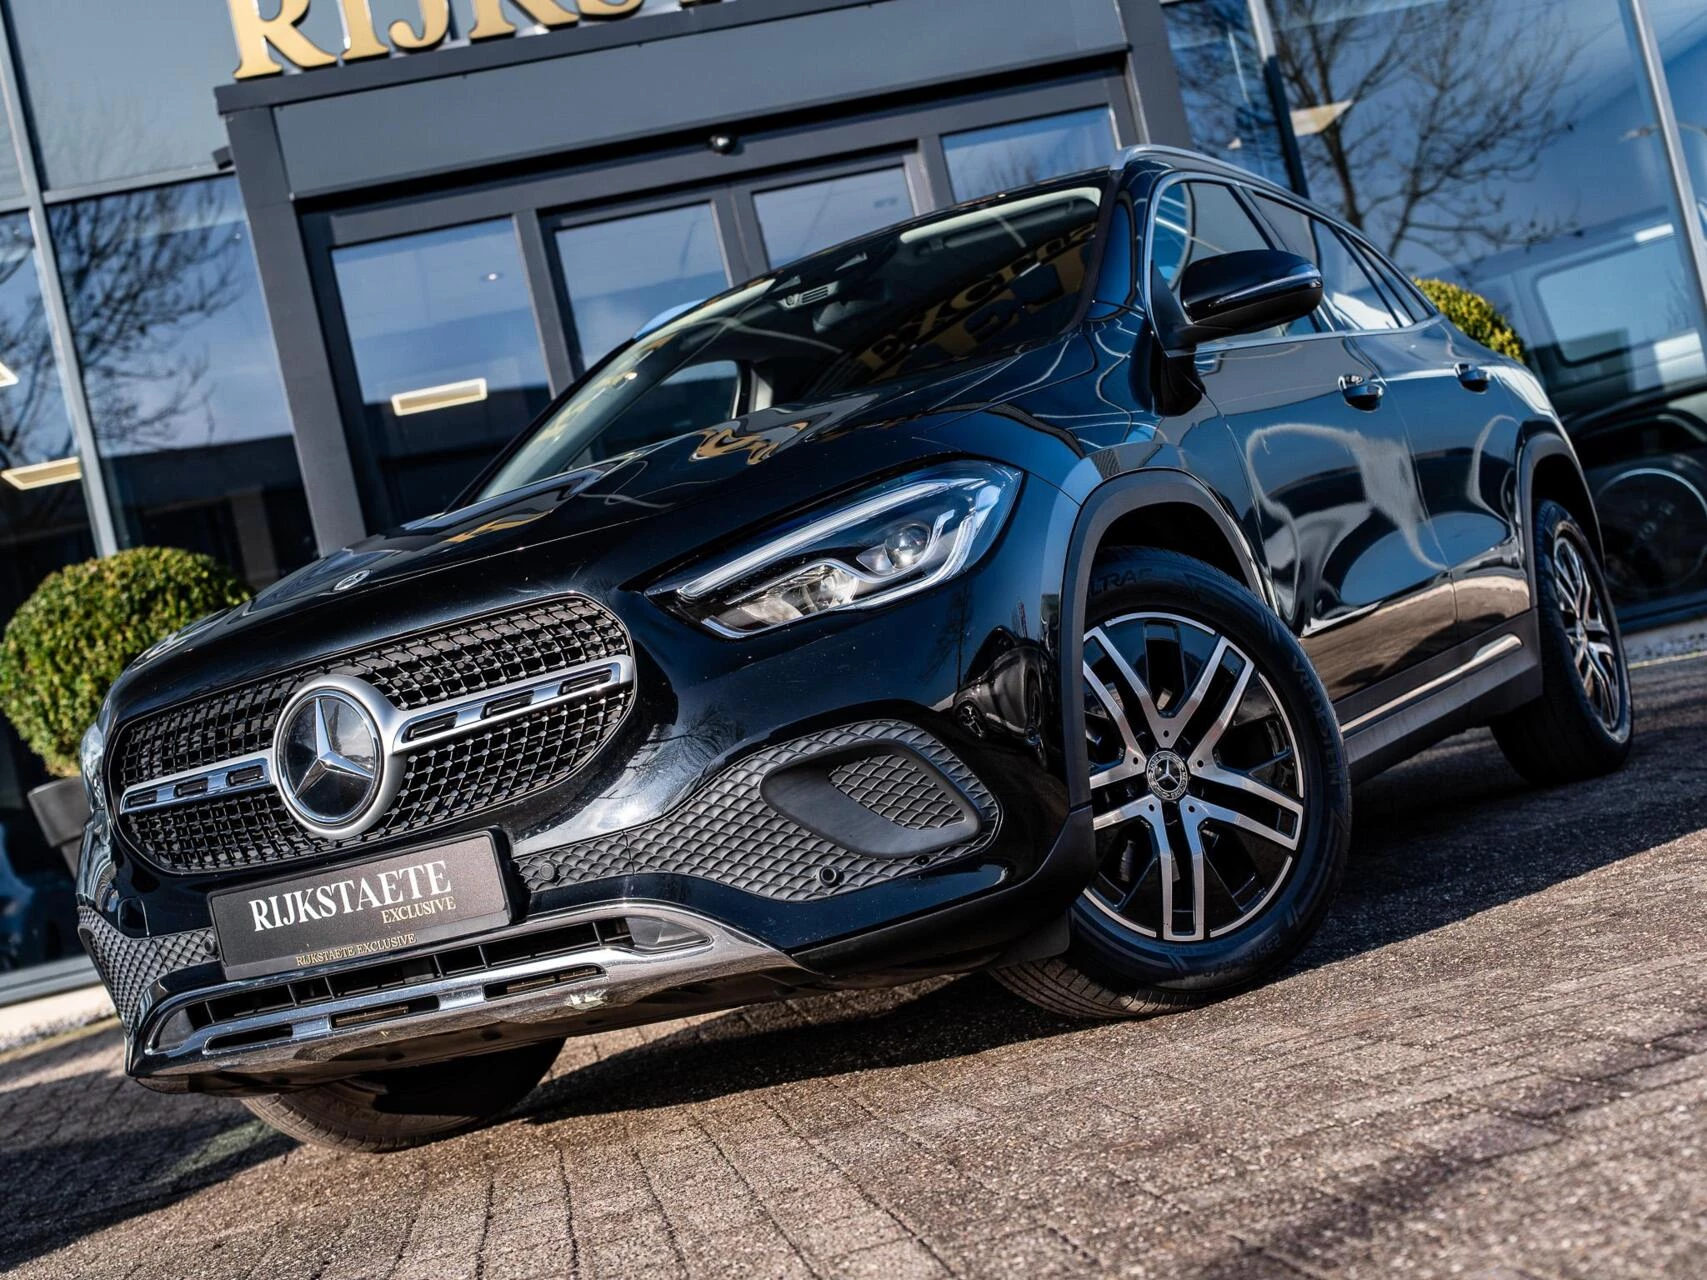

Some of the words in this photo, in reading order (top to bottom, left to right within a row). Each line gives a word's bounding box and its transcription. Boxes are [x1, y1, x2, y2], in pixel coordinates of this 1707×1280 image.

[248, 860, 452, 932] RIJKSTAETE
[381, 896, 456, 925] EXCLUSIVE
[295, 945, 356, 967] RIJKSTAETE
[356, 933, 417, 954] EXCLUSIVE
